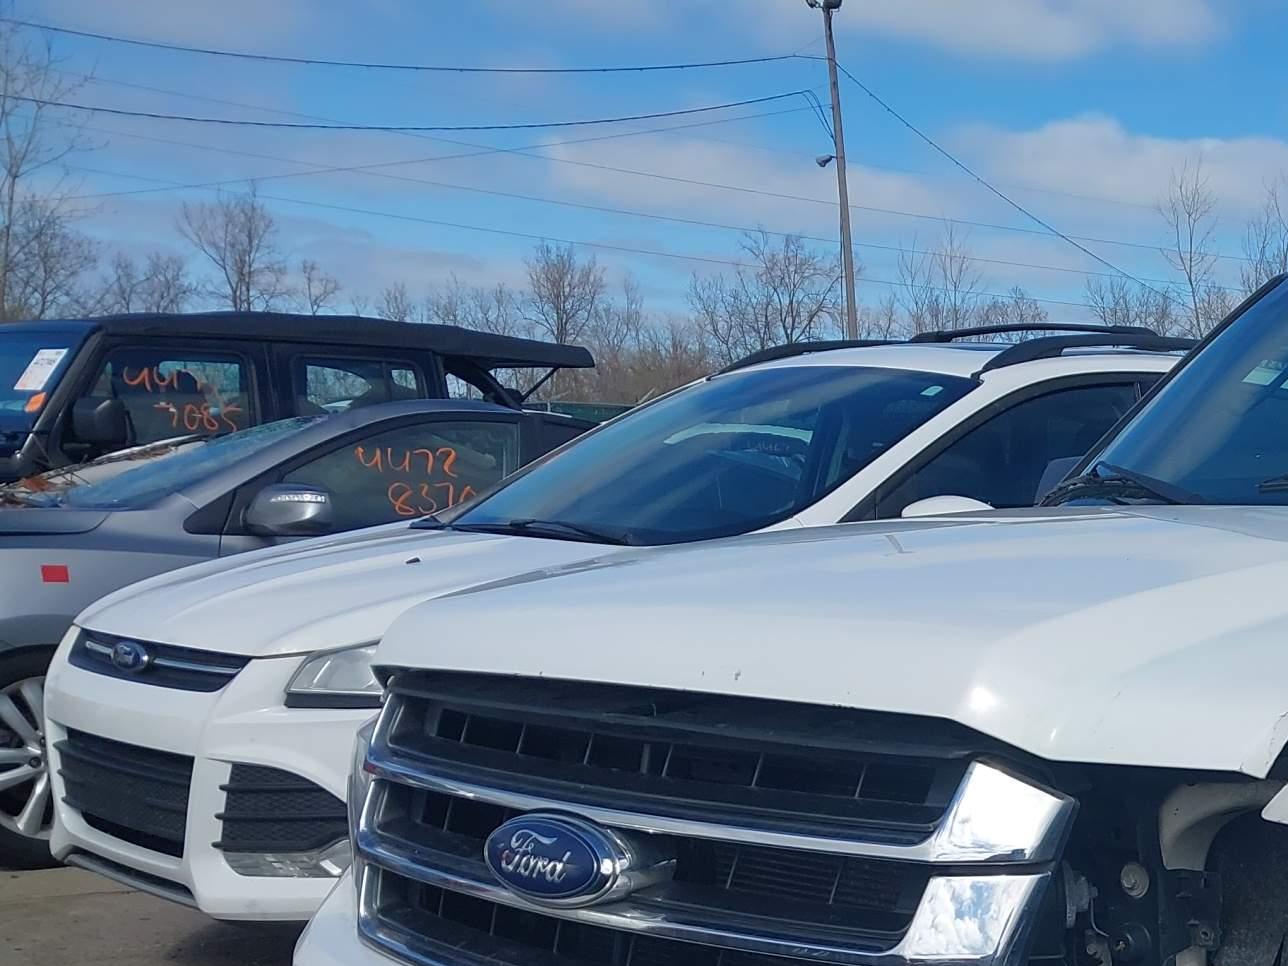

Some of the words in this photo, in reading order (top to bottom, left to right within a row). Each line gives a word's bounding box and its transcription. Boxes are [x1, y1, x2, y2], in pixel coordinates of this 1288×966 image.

[153, 402, 242, 433] 7085
[355, 447, 458, 478] 4472
[501, 829, 572, 883] Ford
